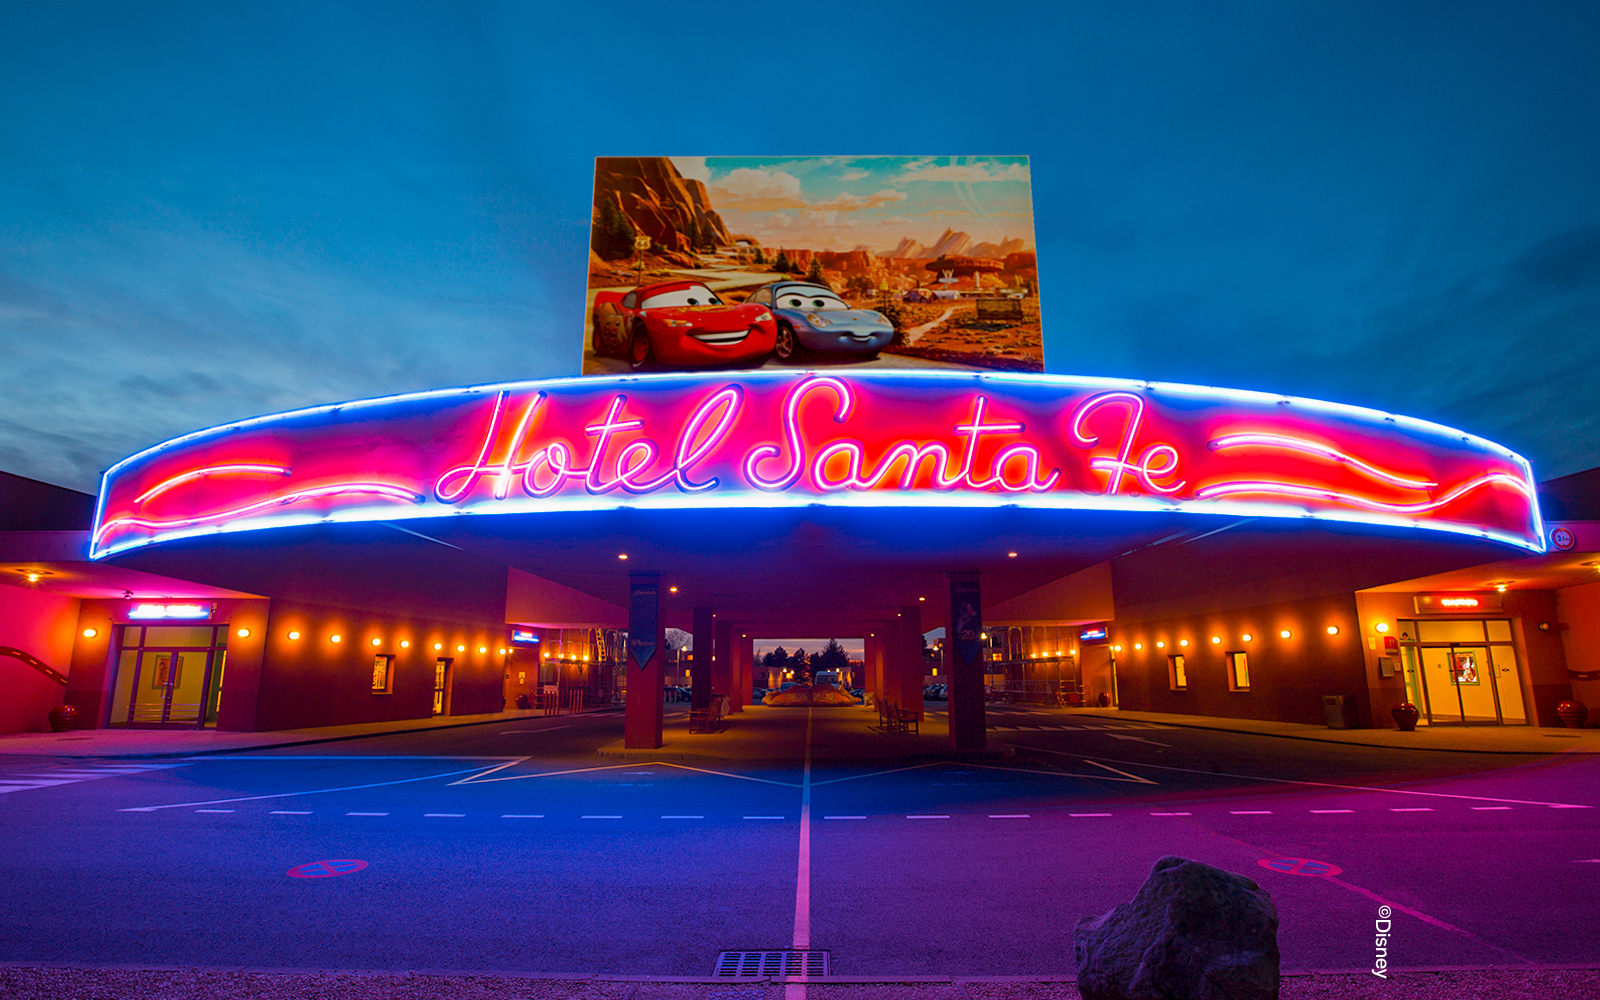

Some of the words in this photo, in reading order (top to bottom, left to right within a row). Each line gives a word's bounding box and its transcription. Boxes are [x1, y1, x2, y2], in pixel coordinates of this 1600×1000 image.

[434, 383, 744, 504] Hotel
[743, 374, 1062, 494] Santa
[1066, 390, 1187, 497] Fe
